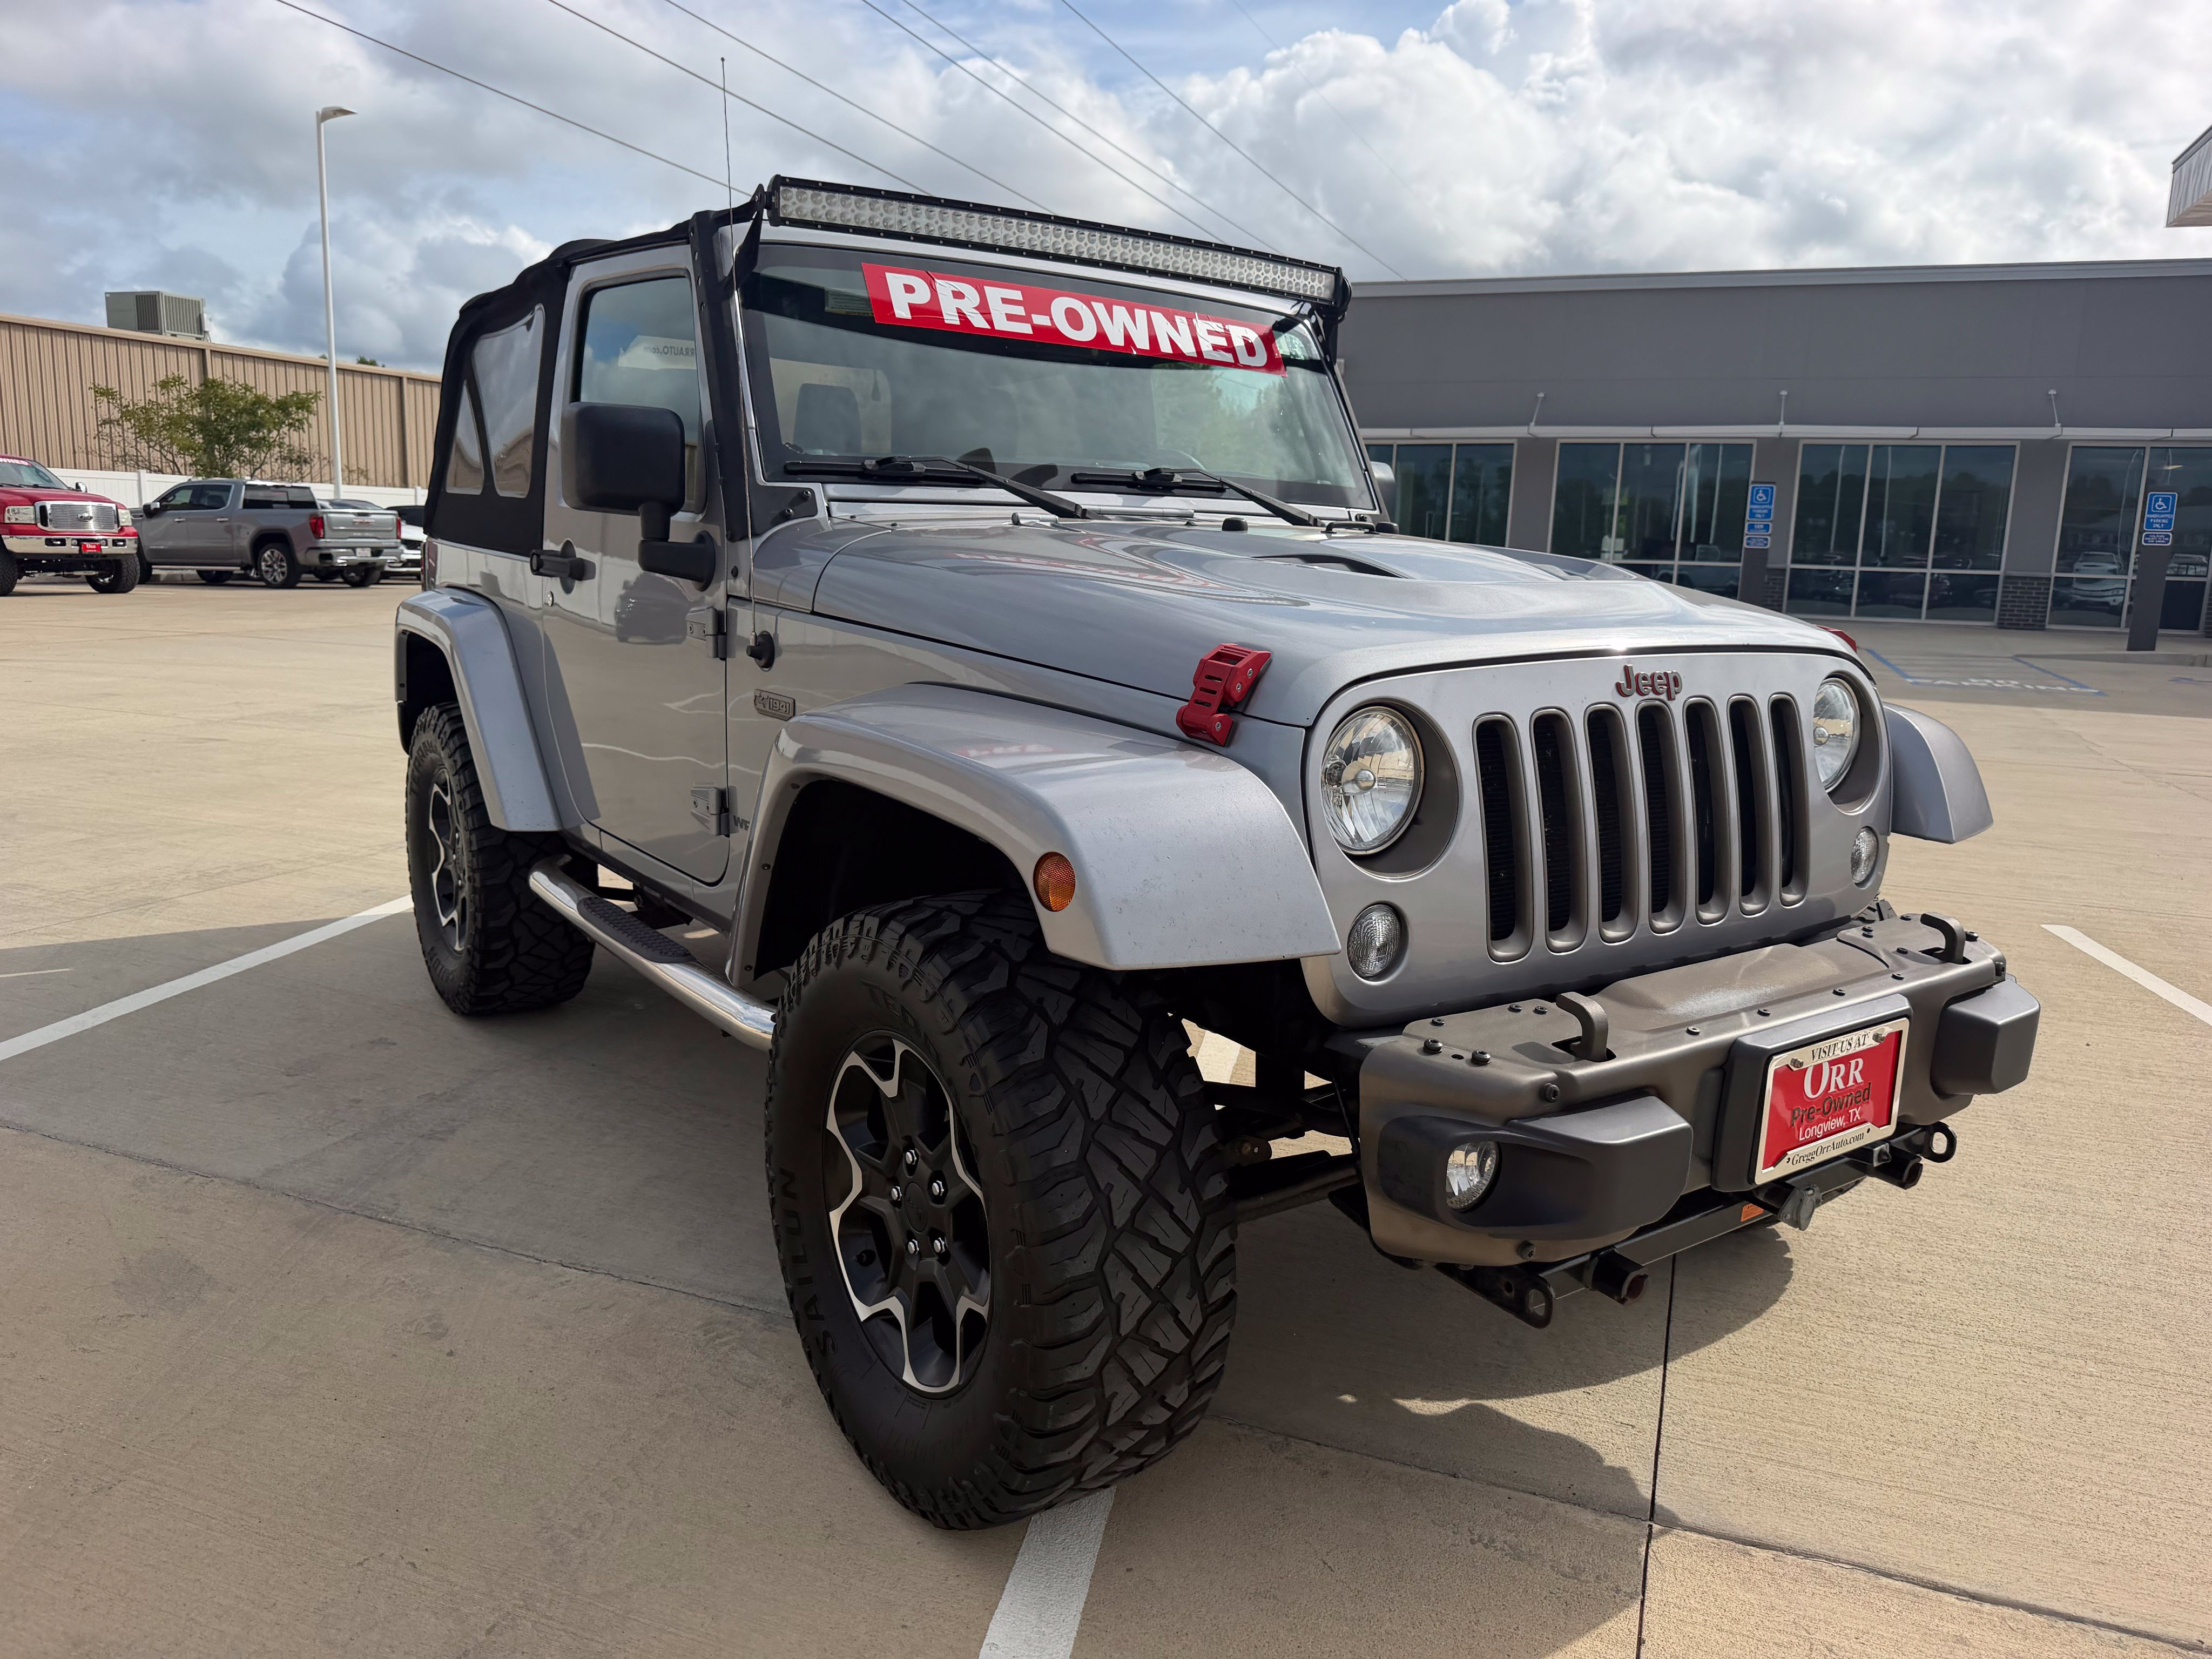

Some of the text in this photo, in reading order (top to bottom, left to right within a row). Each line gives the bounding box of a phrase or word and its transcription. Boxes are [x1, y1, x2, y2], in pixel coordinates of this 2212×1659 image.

[885, 272, 1267, 367] PRE-OWNED
[1615, 664, 1682, 701] Jeep
[769, 697, 790, 715] 1941
[1811, 1033, 1869, 1061] VISIT US AT
[1804, 1058, 1864, 1098] ORR
[1791, 1082, 1872, 1127] Pre-Owned
[1799, 1107, 1862, 1141] Longview, TX
[1791, 1132, 1864, 1166] GreggOrrAuto.com
